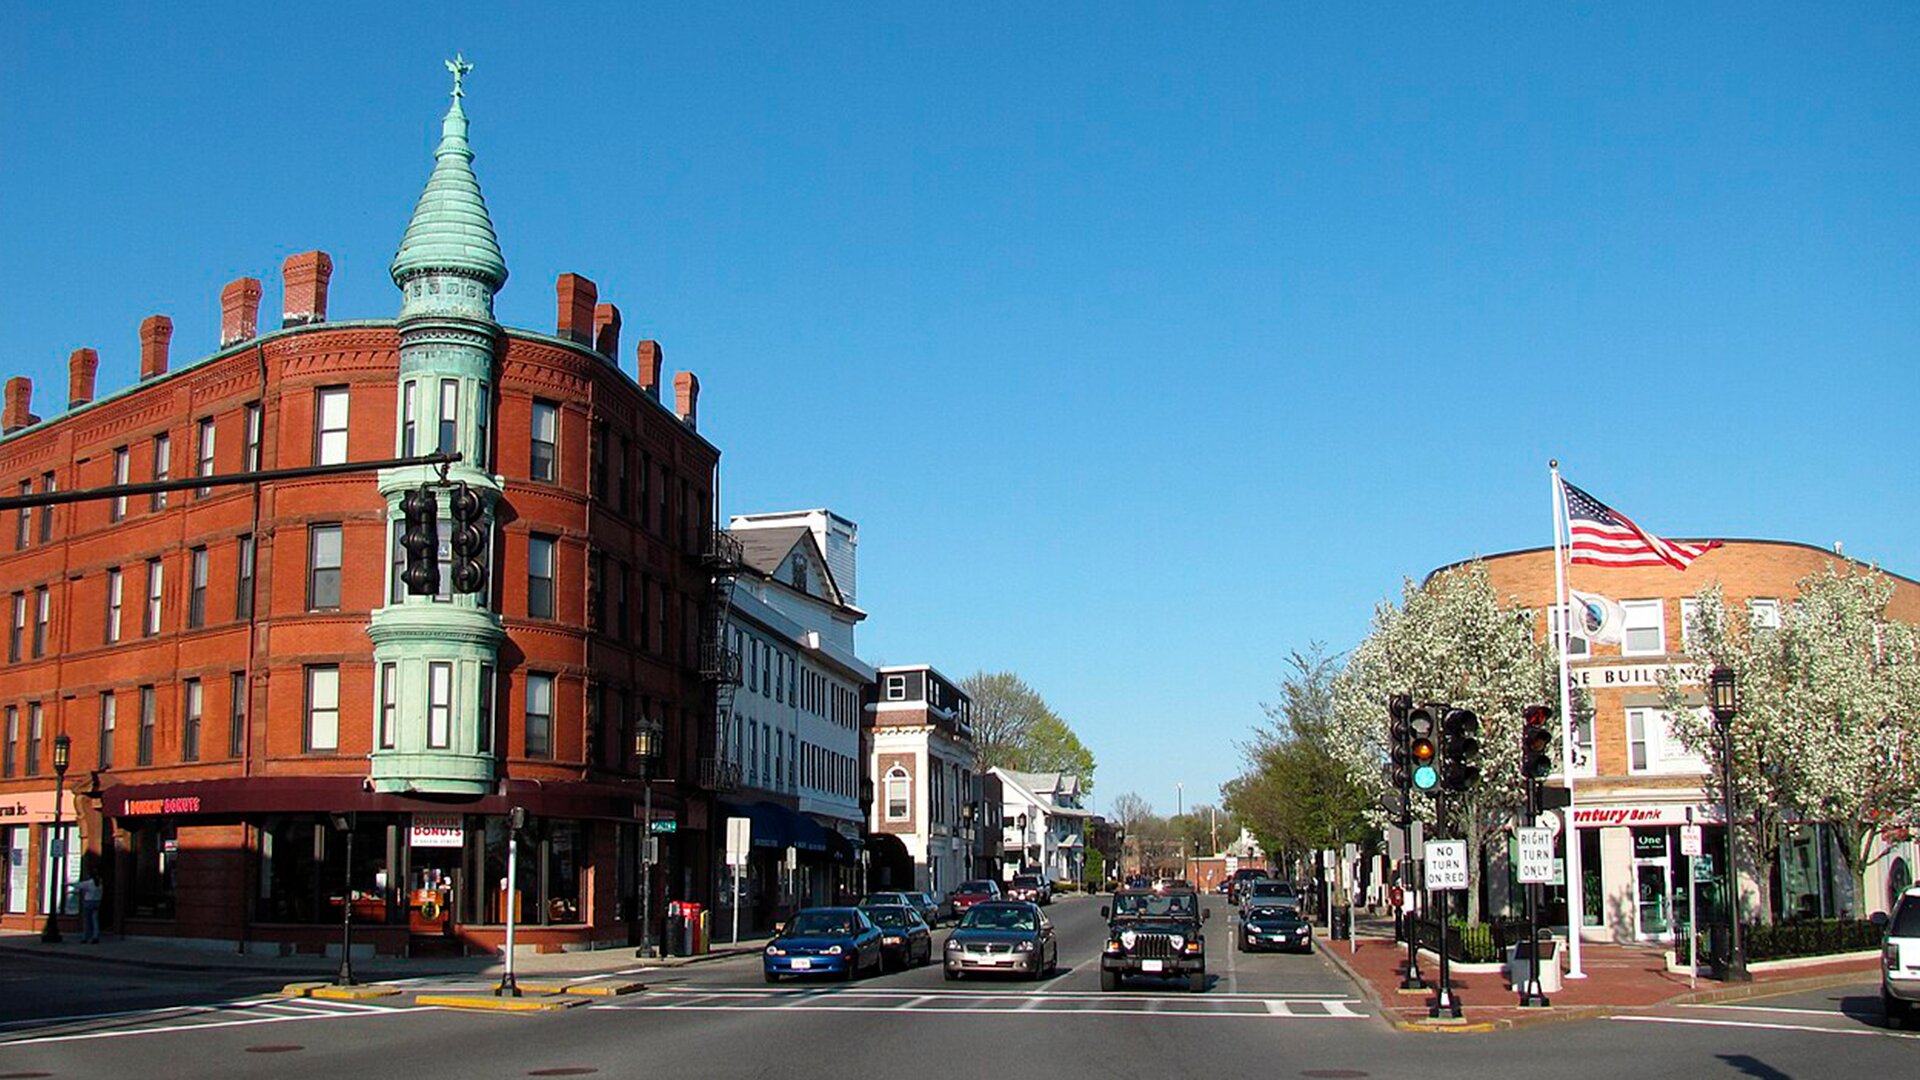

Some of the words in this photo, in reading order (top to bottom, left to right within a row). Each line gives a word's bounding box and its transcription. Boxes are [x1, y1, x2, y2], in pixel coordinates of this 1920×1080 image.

[1604, 667, 1706, 684] BUILDNG
[164, 797, 200, 813] DONUTS
[1629, 809, 1662, 821] Bank
[414, 827, 462, 836] DONUTS
[1521, 832, 1549, 845] RIGHT
[1638, 836, 1662, 845] One
[1437, 846, 1453, 857] NO
[1523, 850, 1549, 861] TURN
[1432, 860, 1460, 870] TURN
[1523, 865, 1548, 877] ONLY
[1428, 873, 1442, 884] ON
[1444, 872, 1464, 883] RED
